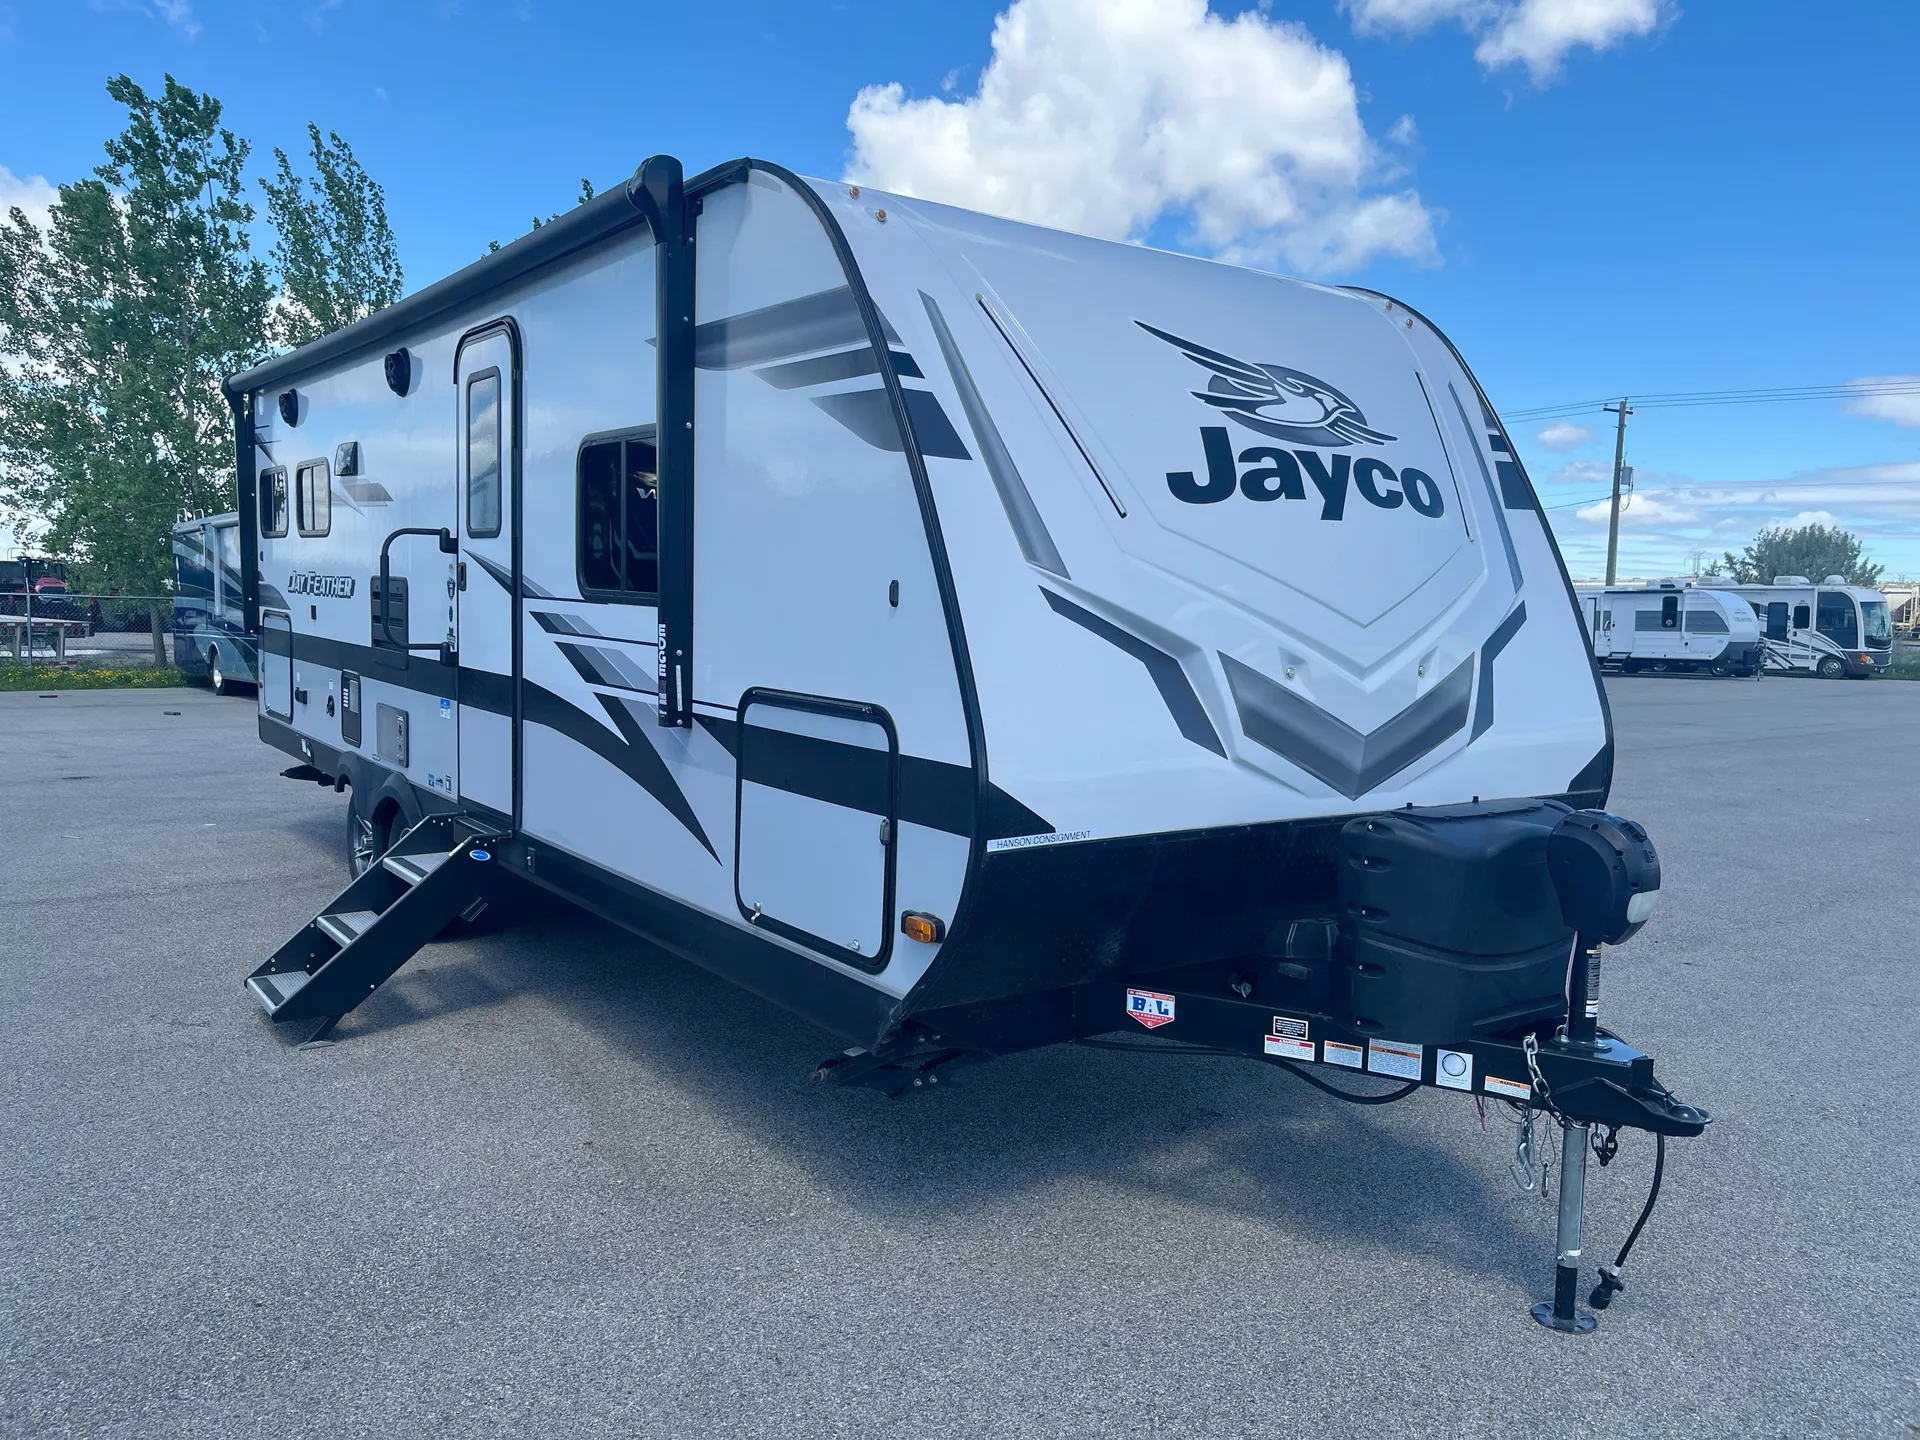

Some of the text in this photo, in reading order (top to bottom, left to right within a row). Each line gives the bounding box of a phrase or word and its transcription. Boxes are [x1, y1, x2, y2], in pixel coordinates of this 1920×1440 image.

[1166, 426, 1445, 521] Jayco
[288, 570, 355, 599] JAY FEATHER
[996, 830, 1091, 849] HANSON CONSIGNMENT
[1132, 996, 1169, 1015] BAL
